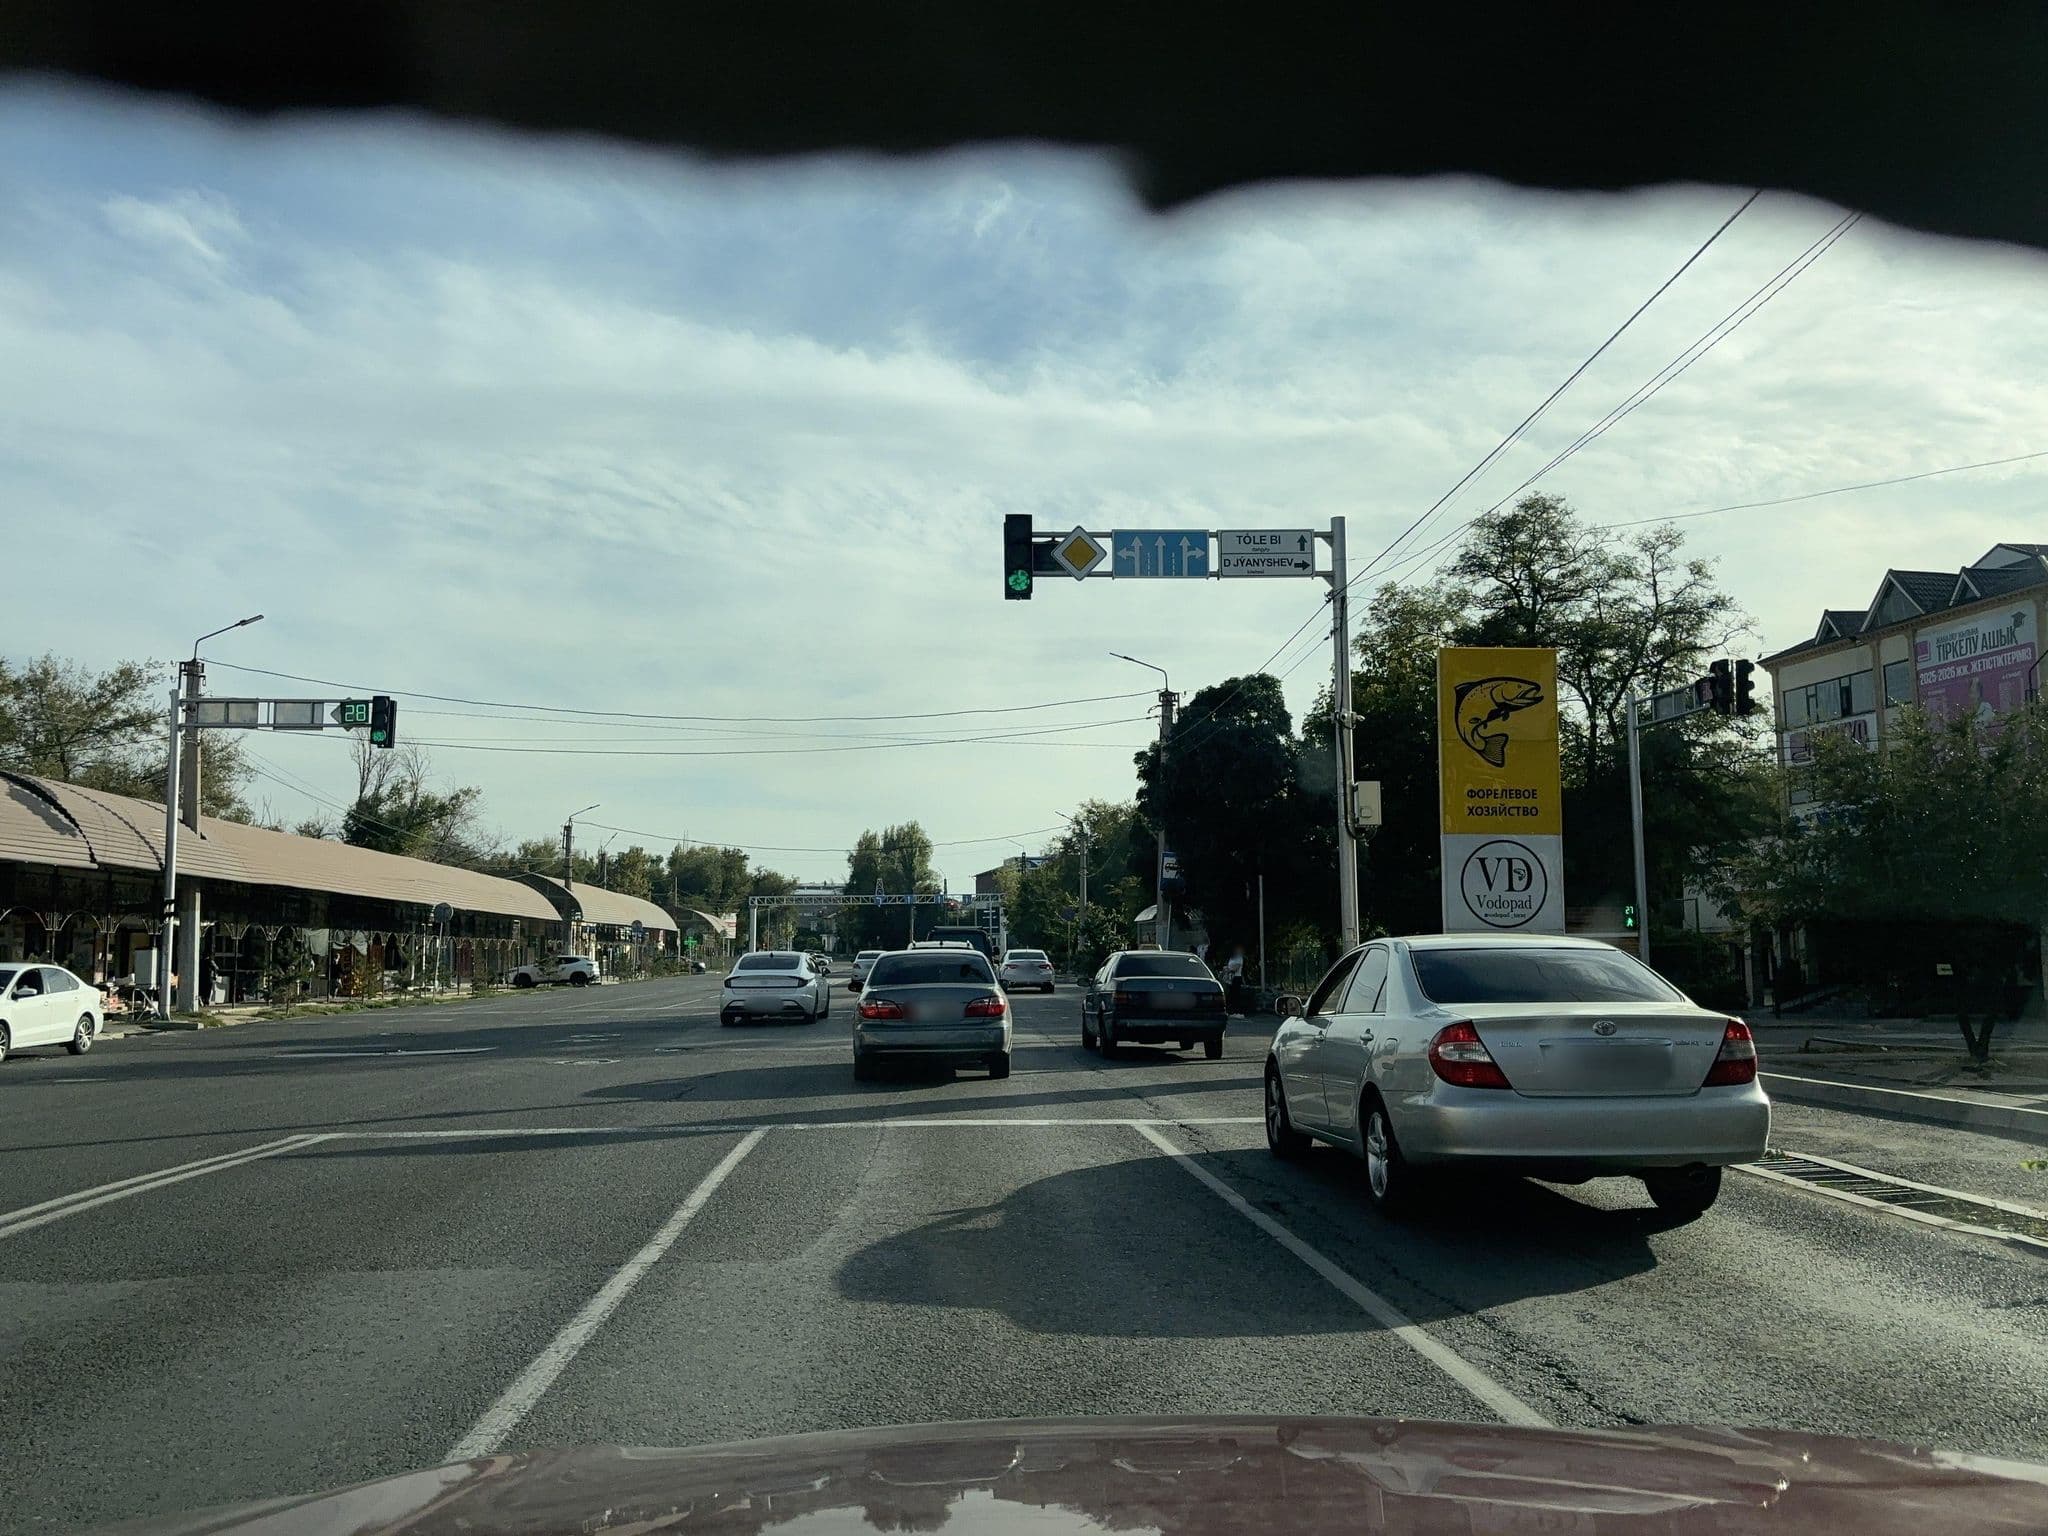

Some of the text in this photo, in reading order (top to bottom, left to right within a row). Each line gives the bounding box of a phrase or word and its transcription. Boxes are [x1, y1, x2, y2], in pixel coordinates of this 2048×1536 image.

[1270, 535, 1281, 545] BI
[1223, 558, 1231, 568] D
[344, 704, 366, 722] 28
[1466, 788, 1538, 800] ФОРЕЛЕВОЕ
[1467, 803, 1539, 817] ХОЗЯЙСТВО
[1476, 857, 1533, 892] VD
[1476, 894, 1532, 912] Vodopad
